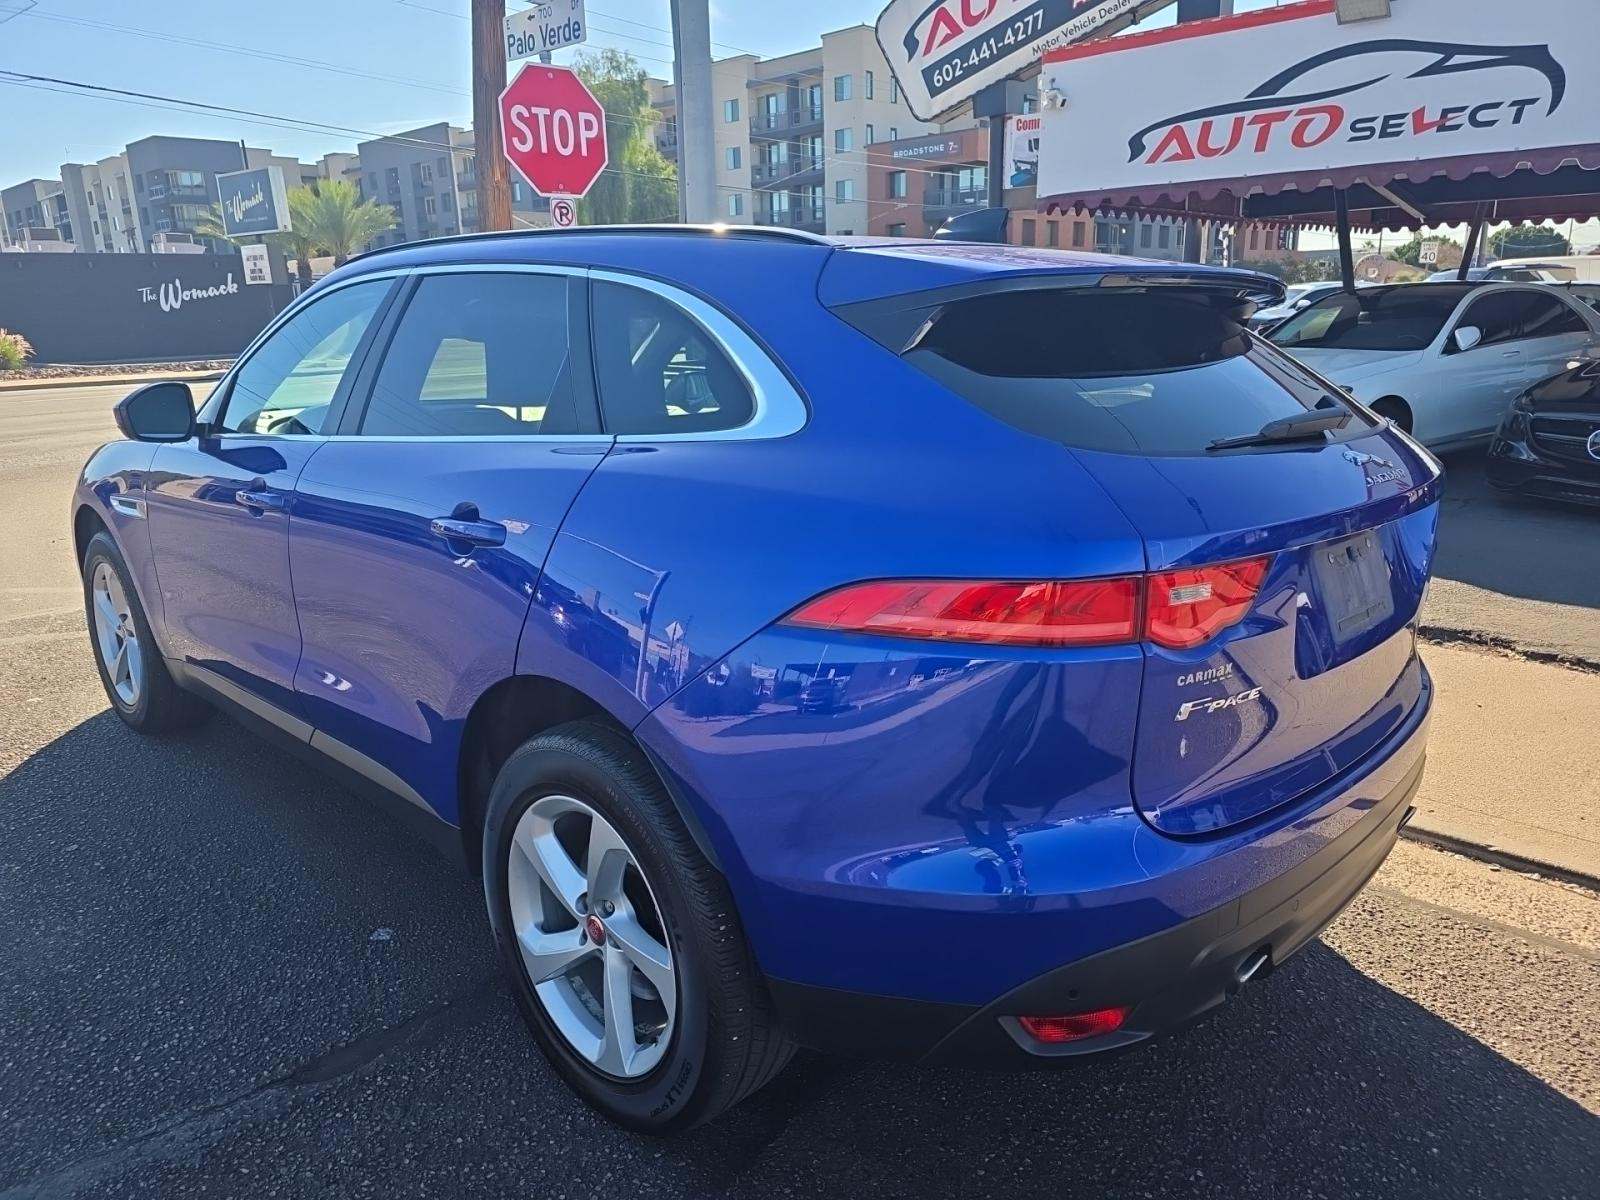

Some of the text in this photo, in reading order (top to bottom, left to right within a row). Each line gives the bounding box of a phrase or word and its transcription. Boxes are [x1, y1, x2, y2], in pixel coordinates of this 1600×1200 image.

[538, 6, 553, 20] 700
[922, 0, 1019, 57] AU
[1032, 0, 1133, 56] Motor Vehicle Dealer
[507, 16, 581, 58] Palo Verde
[933, 9, 1045, 88] 602-441-4277
[510, 104, 599, 157] STOP
[1144, 97, 1541, 164] AUTO SELECT
[893, 144, 945, 158] BROADSTONE
[1421, 251, 1436, 261] 40
[137, 273, 239, 312] The Womack
[1365, 468, 1406, 487] JAGUAR
[1174, 686, 1263, 722] F-PACE
